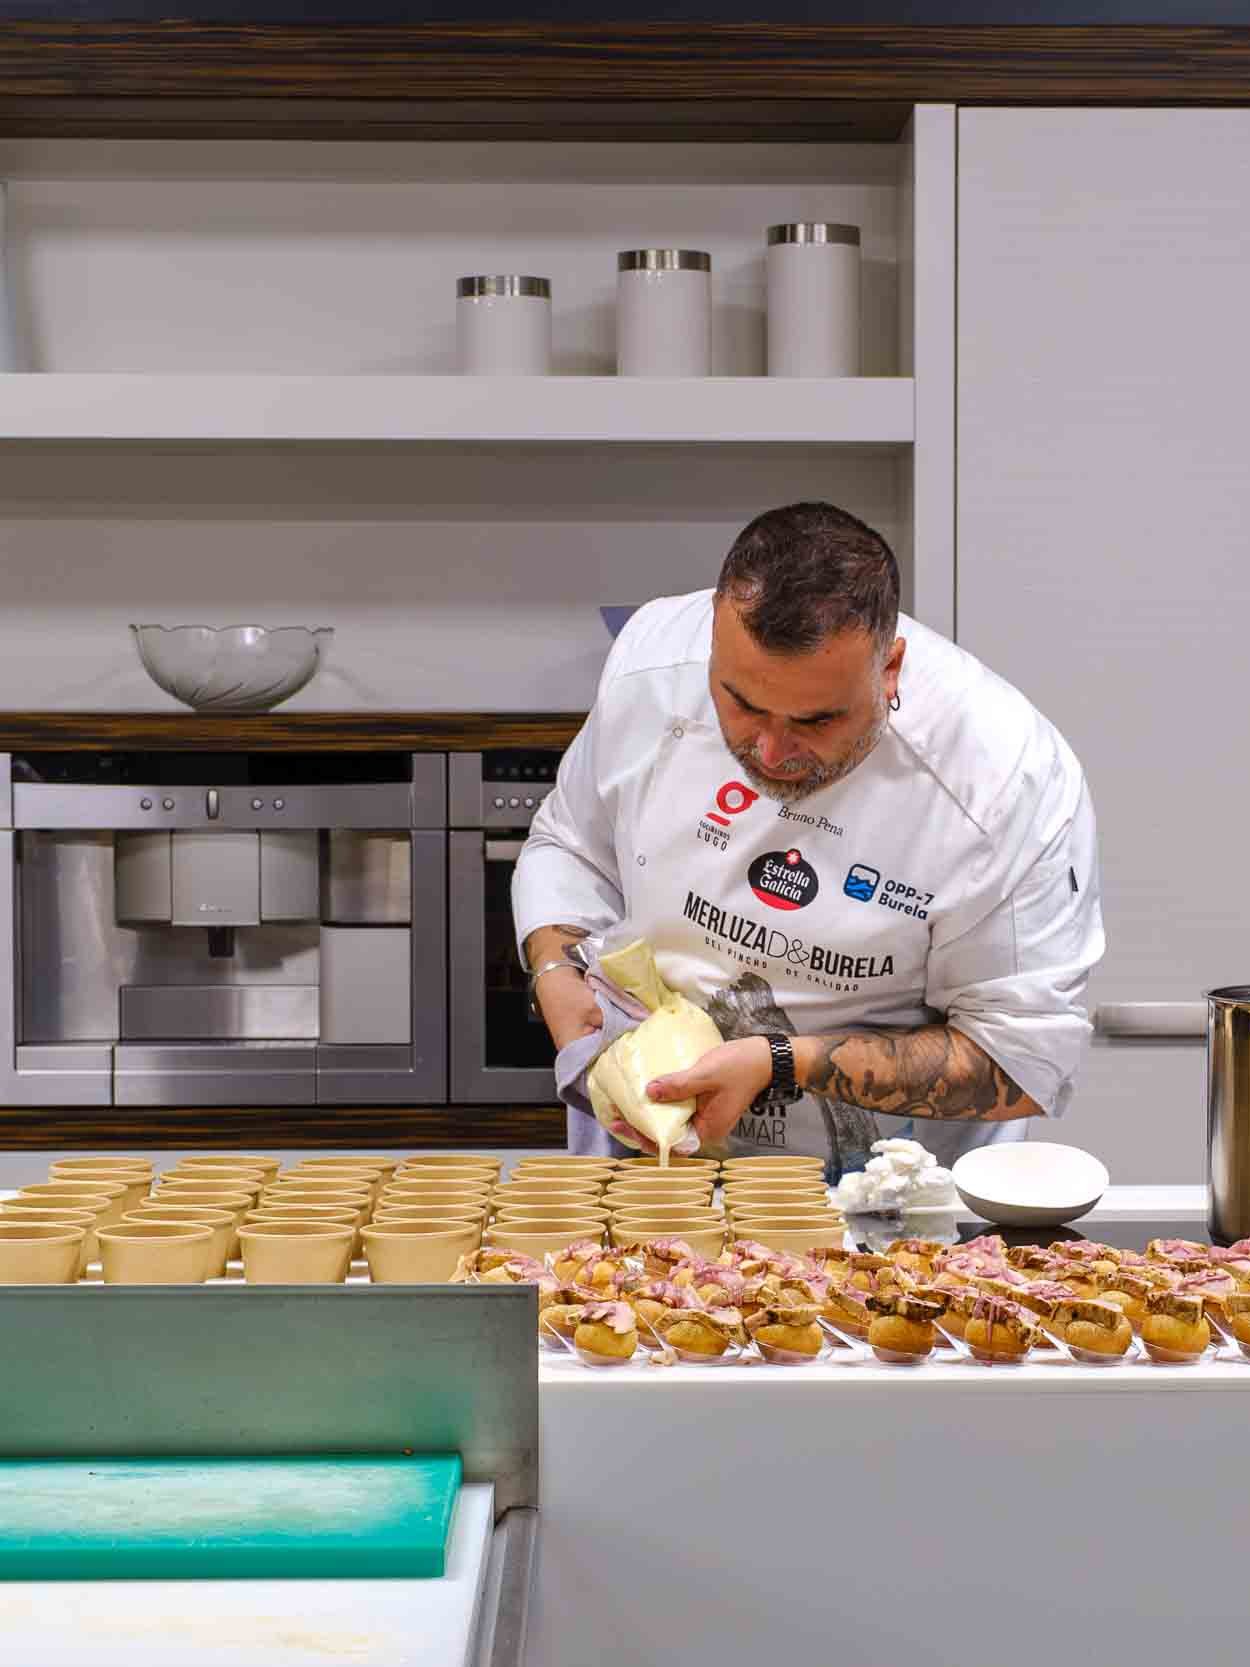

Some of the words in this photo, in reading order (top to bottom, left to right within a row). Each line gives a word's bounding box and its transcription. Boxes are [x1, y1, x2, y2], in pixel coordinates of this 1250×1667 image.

[777, 805, 815, 825] Bruno
[697, 829, 728, 851] LUGO
[760, 873, 803, 901] Galicia
[763, 859, 810, 888] Estrella
[878, 892, 929, 920] Burela
[884, 879, 935, 905] OPP-7
[705, 936, 721, 952] DEL
[728, 948, 768, 969] PINCHO
[785, 968, 798, 977] DE
[807, 974, 859, 992] CALIDAD
